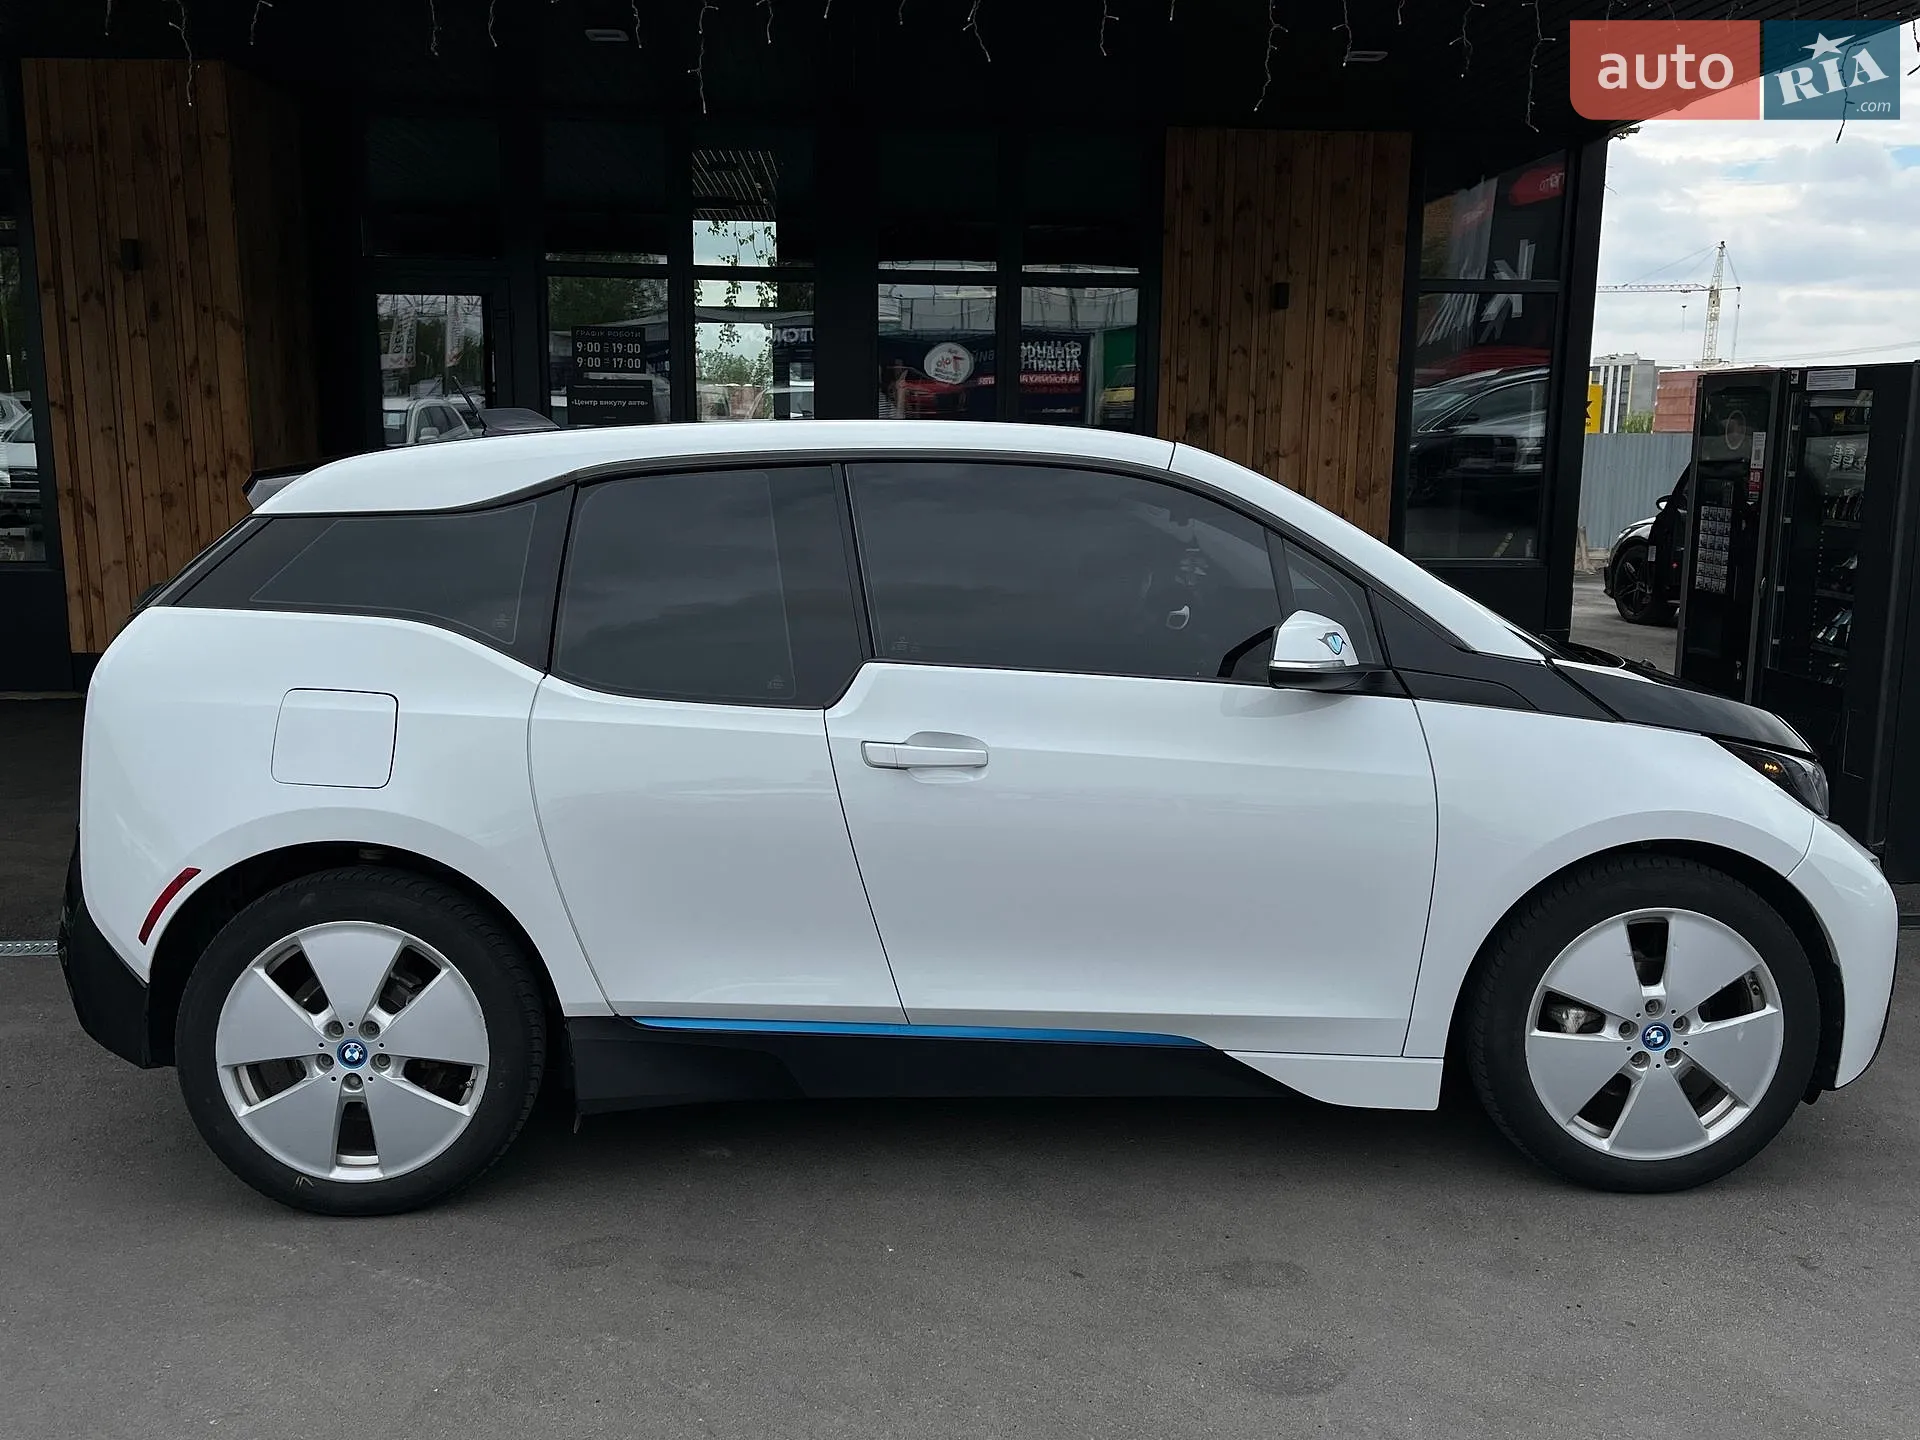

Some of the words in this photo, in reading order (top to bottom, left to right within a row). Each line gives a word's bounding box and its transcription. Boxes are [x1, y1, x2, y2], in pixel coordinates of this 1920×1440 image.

[576, 342, 601, 353] 9:00
[612, 343, 641, 354] 19:00
[576, 357, 601, 368] 9:00
[612, 357, 641, 369] 17:00
